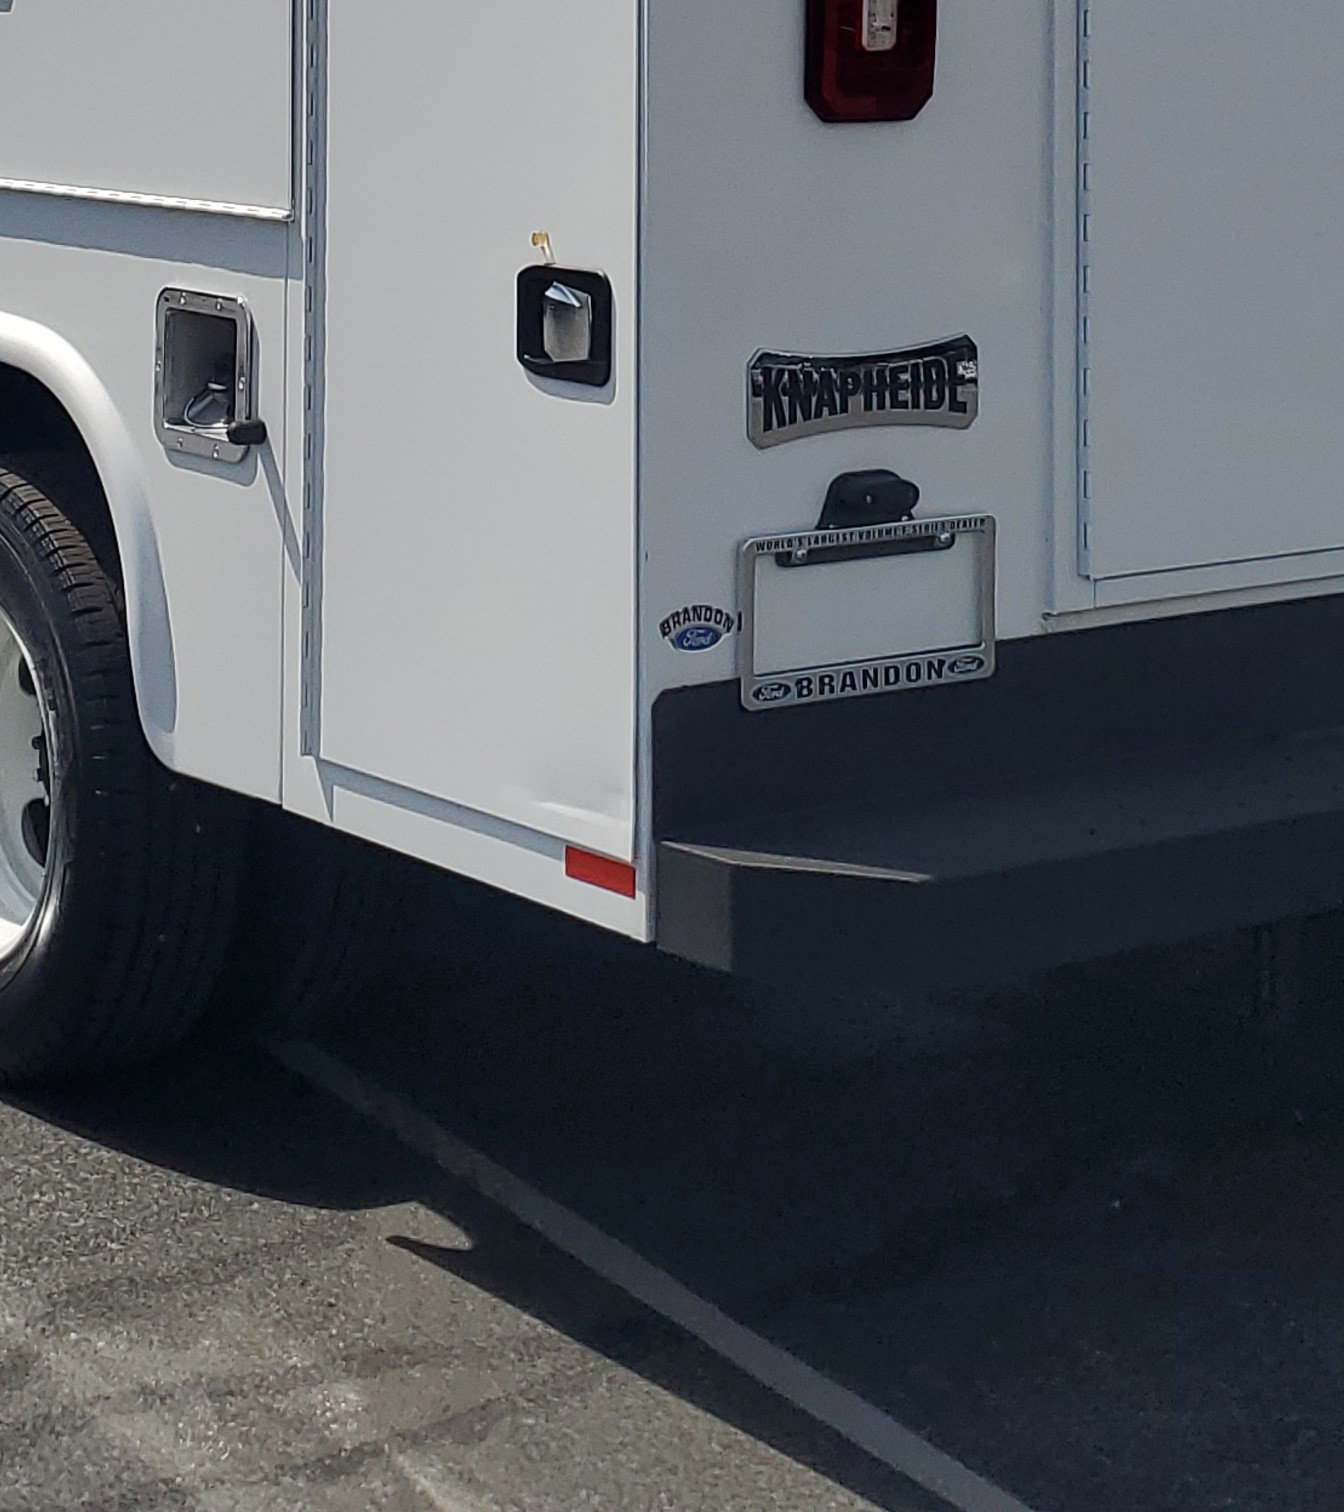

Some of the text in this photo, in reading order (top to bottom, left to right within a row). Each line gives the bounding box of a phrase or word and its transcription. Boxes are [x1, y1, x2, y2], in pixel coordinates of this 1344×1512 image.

[761, 350, 970, 433] KNAPHEIDE
[756, 536, 803, 551] WORLD'S
[659, 604, 734, 639] BRANDON
[678, 629, 715, 647] Ford
[758, 683, 787, 701] Ford
[795, 658, 946, 698] BRANDON
